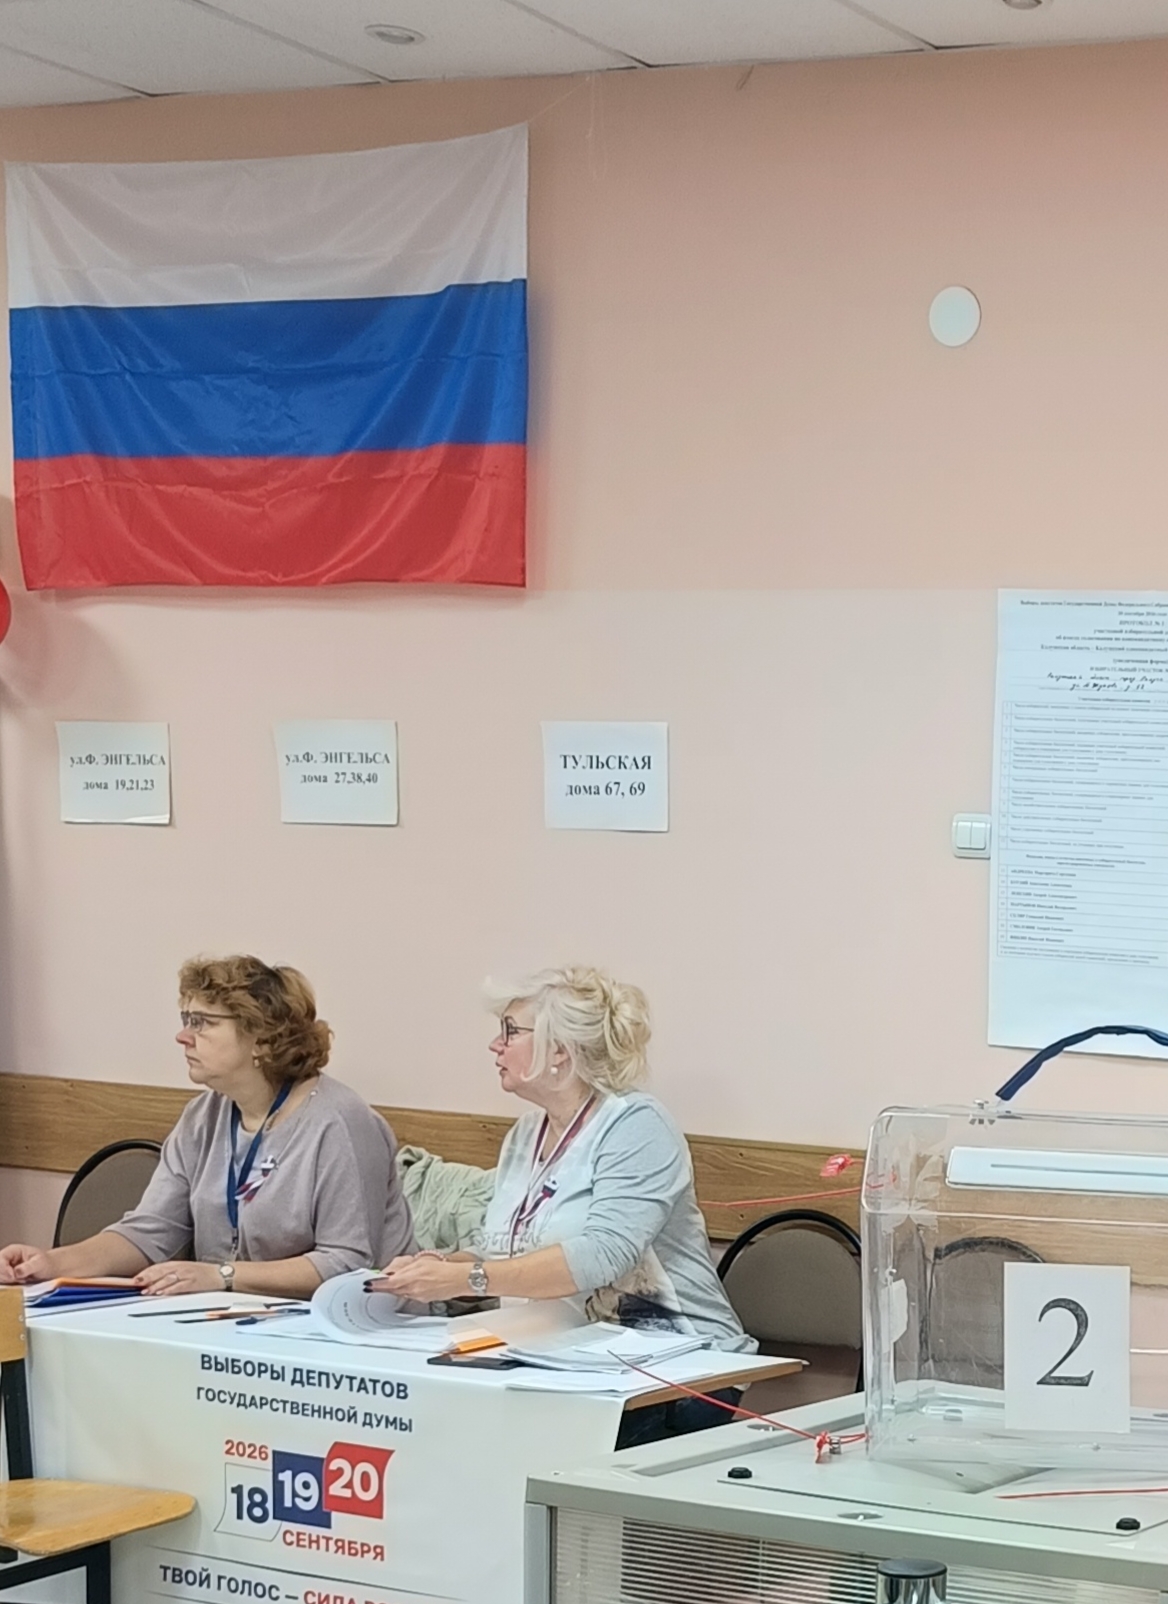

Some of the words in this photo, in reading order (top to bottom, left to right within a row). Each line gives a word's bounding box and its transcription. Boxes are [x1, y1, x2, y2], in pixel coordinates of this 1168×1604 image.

[101, 753, 166, 766] ЭНГЕЛЬСА
[320, 751, 391, 764] ЭНГЕЛЬСА
[560, 754, 652, 770] ТУЛЬСКАЯ
[82, 780, 109, 791] дома
[114, 778, 155, 791] 19,21,23
[300, 773, 328, 784] дома
[334, 771, 379, 785] 27,38,40
[565, 783, 601, 797] дома
[604, 781, 625, 798] 67,
[629, 781, 646, 796] 69
[1036, 1297, 1095, 1388] 2
[200, 1354, 285, 1382] ВЫБОРЫ
[291, 1367, 409, 1400] ДЕПУТАТОВ
[196, 1386, 358, 1424] ГОСУДАРСТВЕННОЙ
[362, 1410, 413, 1433] ДУМЫ
[224, 1439, 269, 1461] 2026
[230, 1484, 270, 1524] 18
[277, 1469, 320, 1511] 19
[328, 1457, 379, 1501] 20
[282, 1529, 385, 1561] СЕНТЯБРЯ
[159, 1564, 211, 1589] ТВОЙ
[217, 1574, 280, 1601] ГОЛОС
